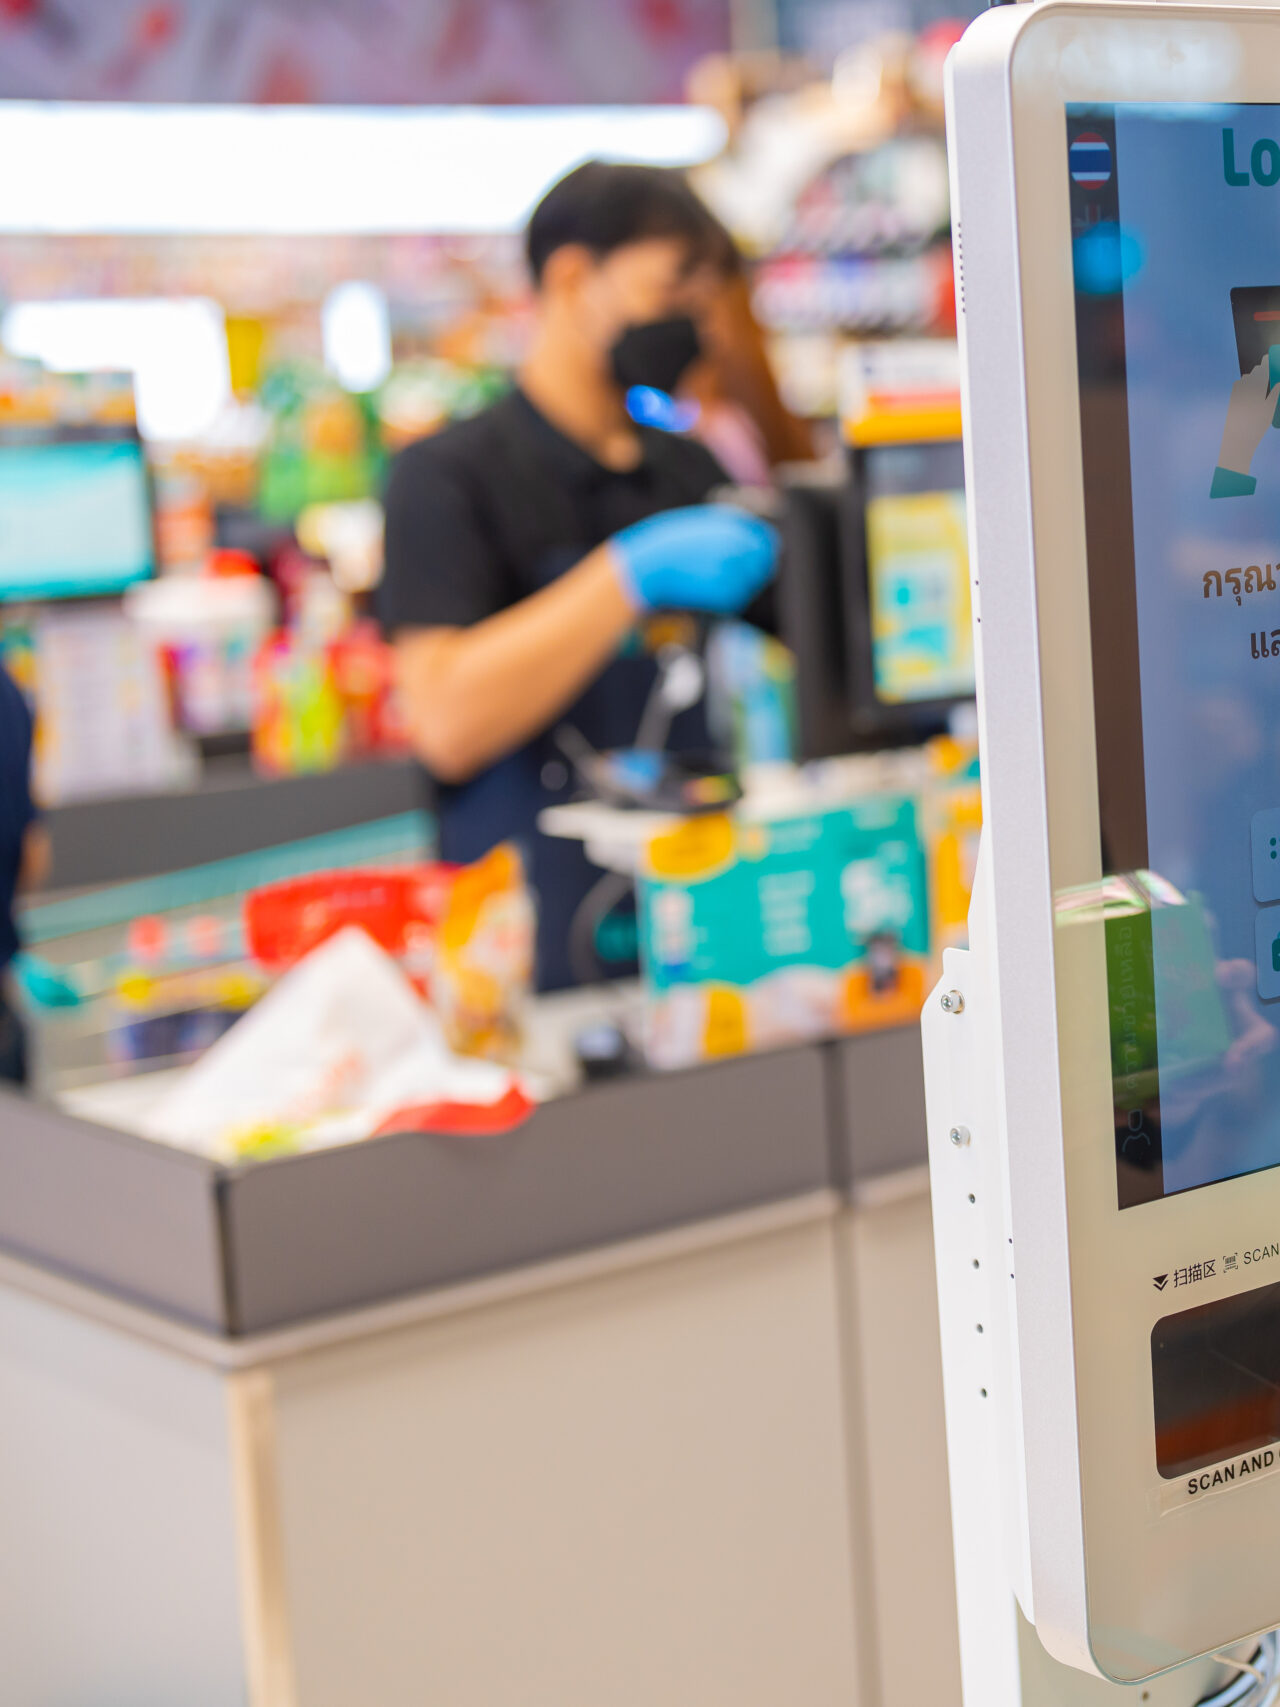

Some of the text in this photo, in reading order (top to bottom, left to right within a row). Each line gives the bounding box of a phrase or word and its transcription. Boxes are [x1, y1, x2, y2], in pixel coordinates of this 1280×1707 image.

[1173, 1243, 1280, 1288] 扫描区 SCAN
[1188, 1464, 1235, 1495] SCAN
[1239, 1450, 1274, 1476] AND
